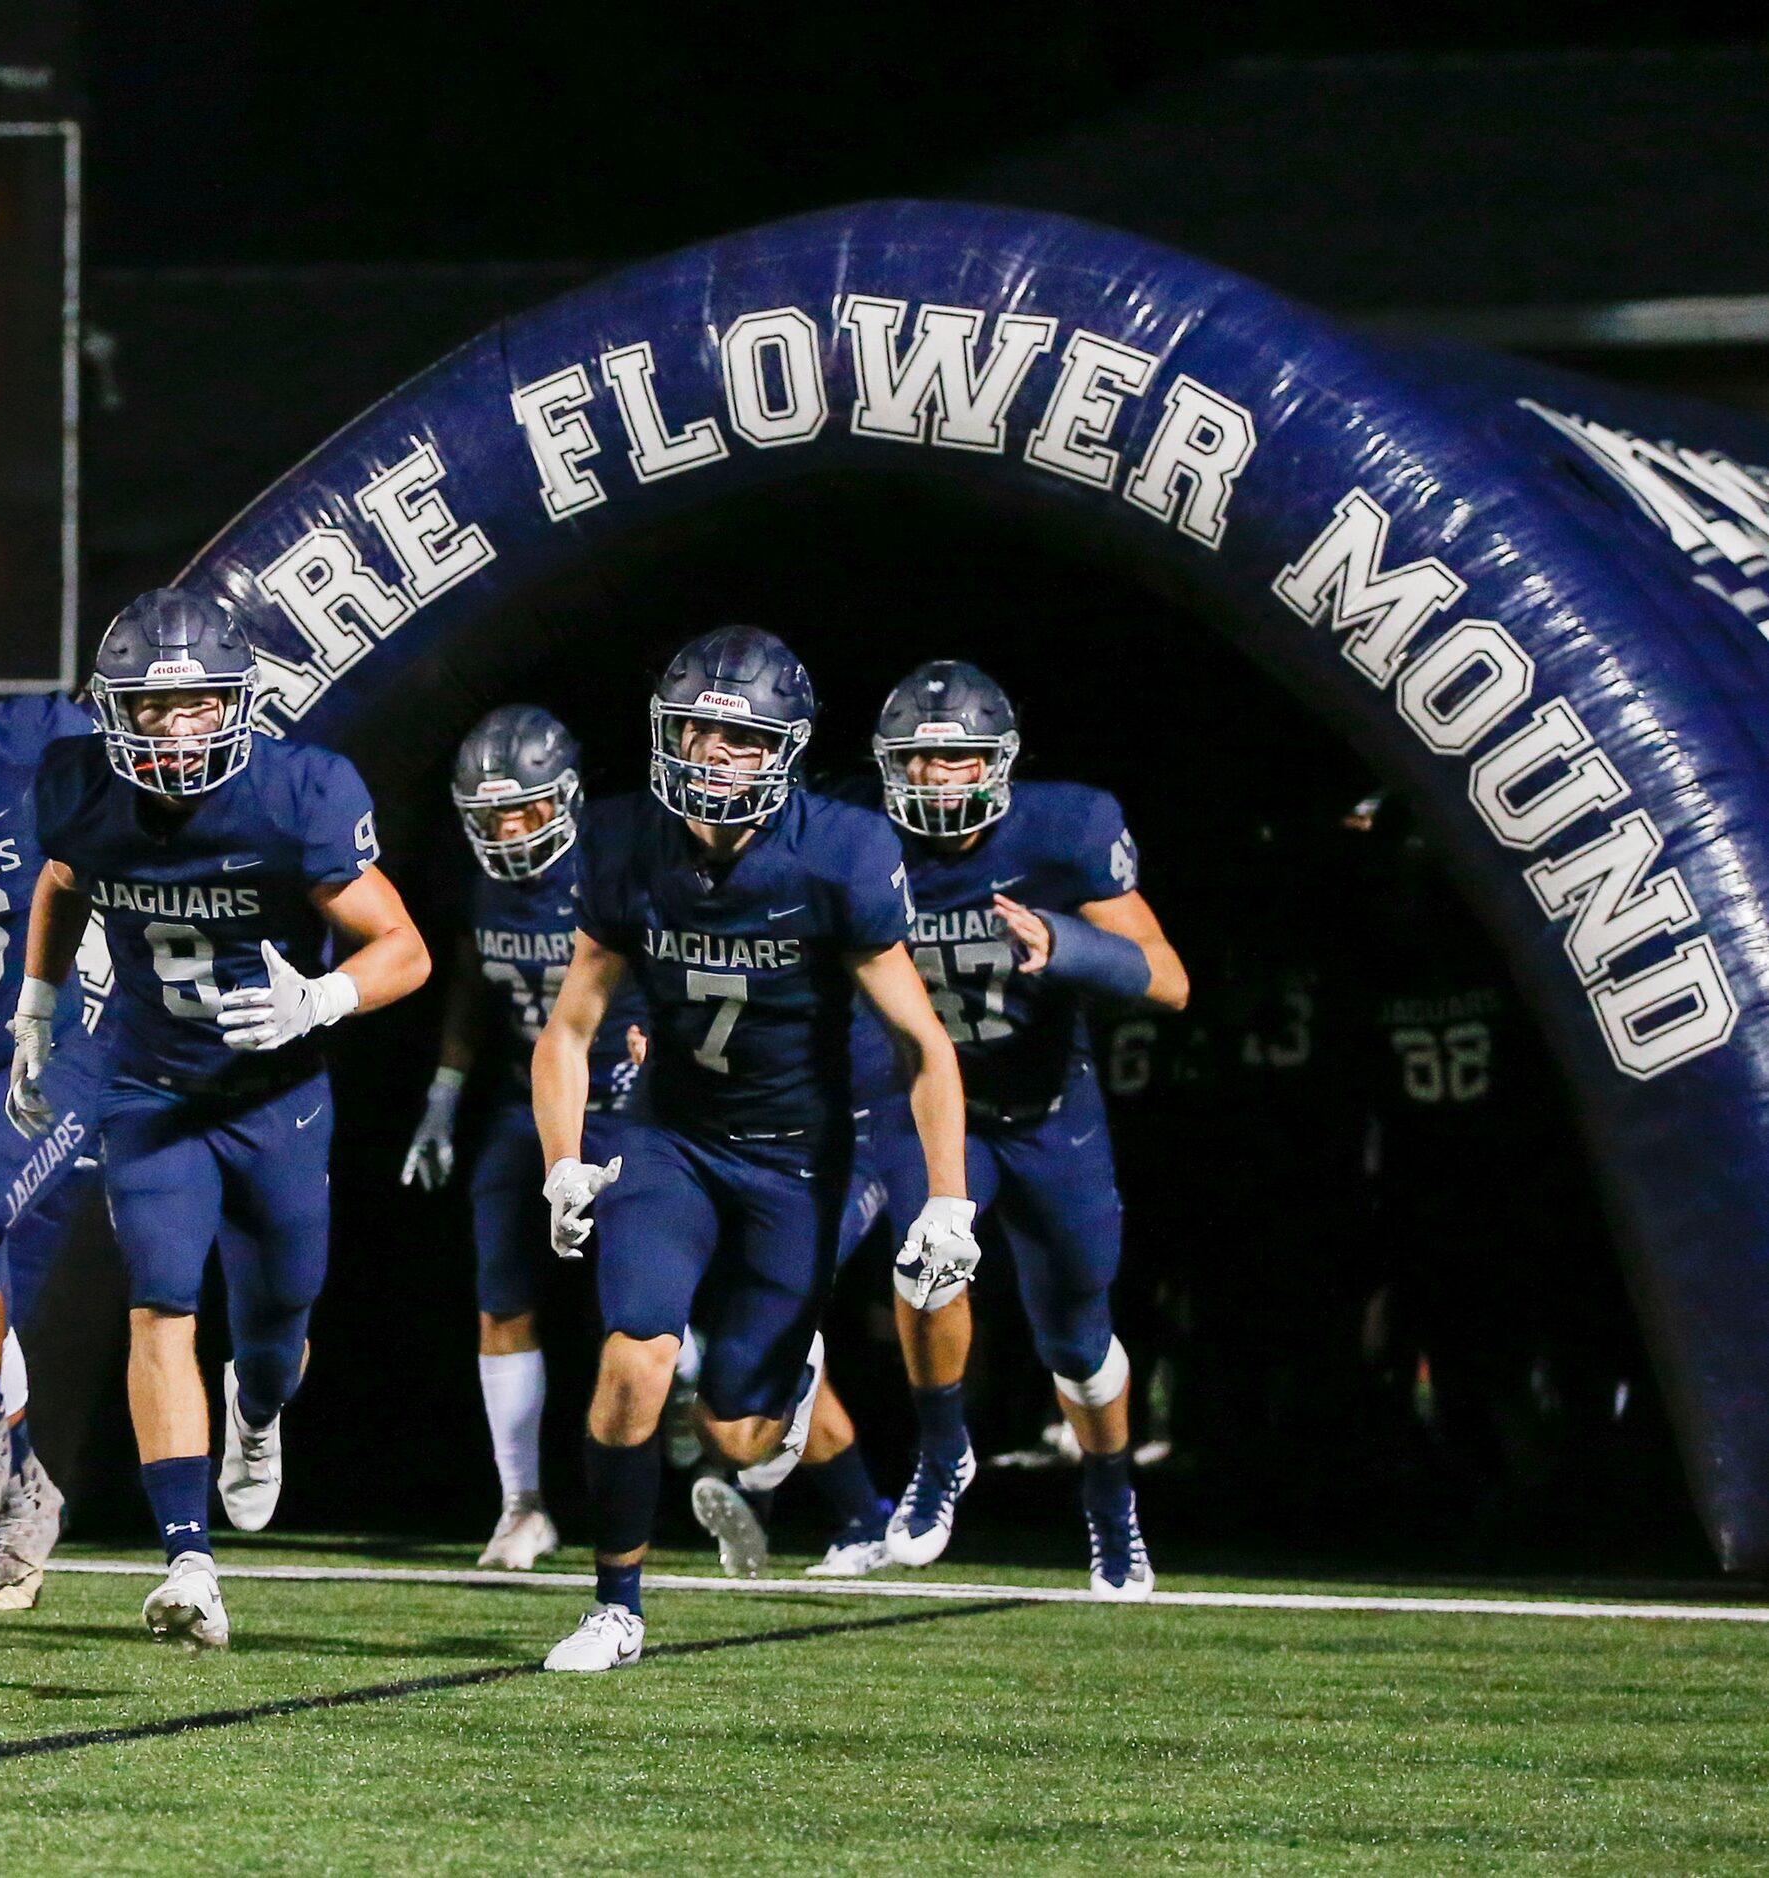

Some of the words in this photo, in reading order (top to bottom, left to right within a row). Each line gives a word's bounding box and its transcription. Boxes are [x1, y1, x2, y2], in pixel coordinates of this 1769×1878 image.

[510, 292, 1257, 550] FLOWER
[1271, 487, 1740, 1082] MOUND
[702, 693, 745, 708] Riddell
[354, 810, 381, 872] 9
[91, 880, 261, 919] JAGUARS
[890, 861, 916, 925] 7
[143, 921, 224, 1019] 9
[643, 928, 802, 969] JAGUARS
[686, 969, 748, 1074] 7
[5, 1111, 85, 1230] JAGUARS
